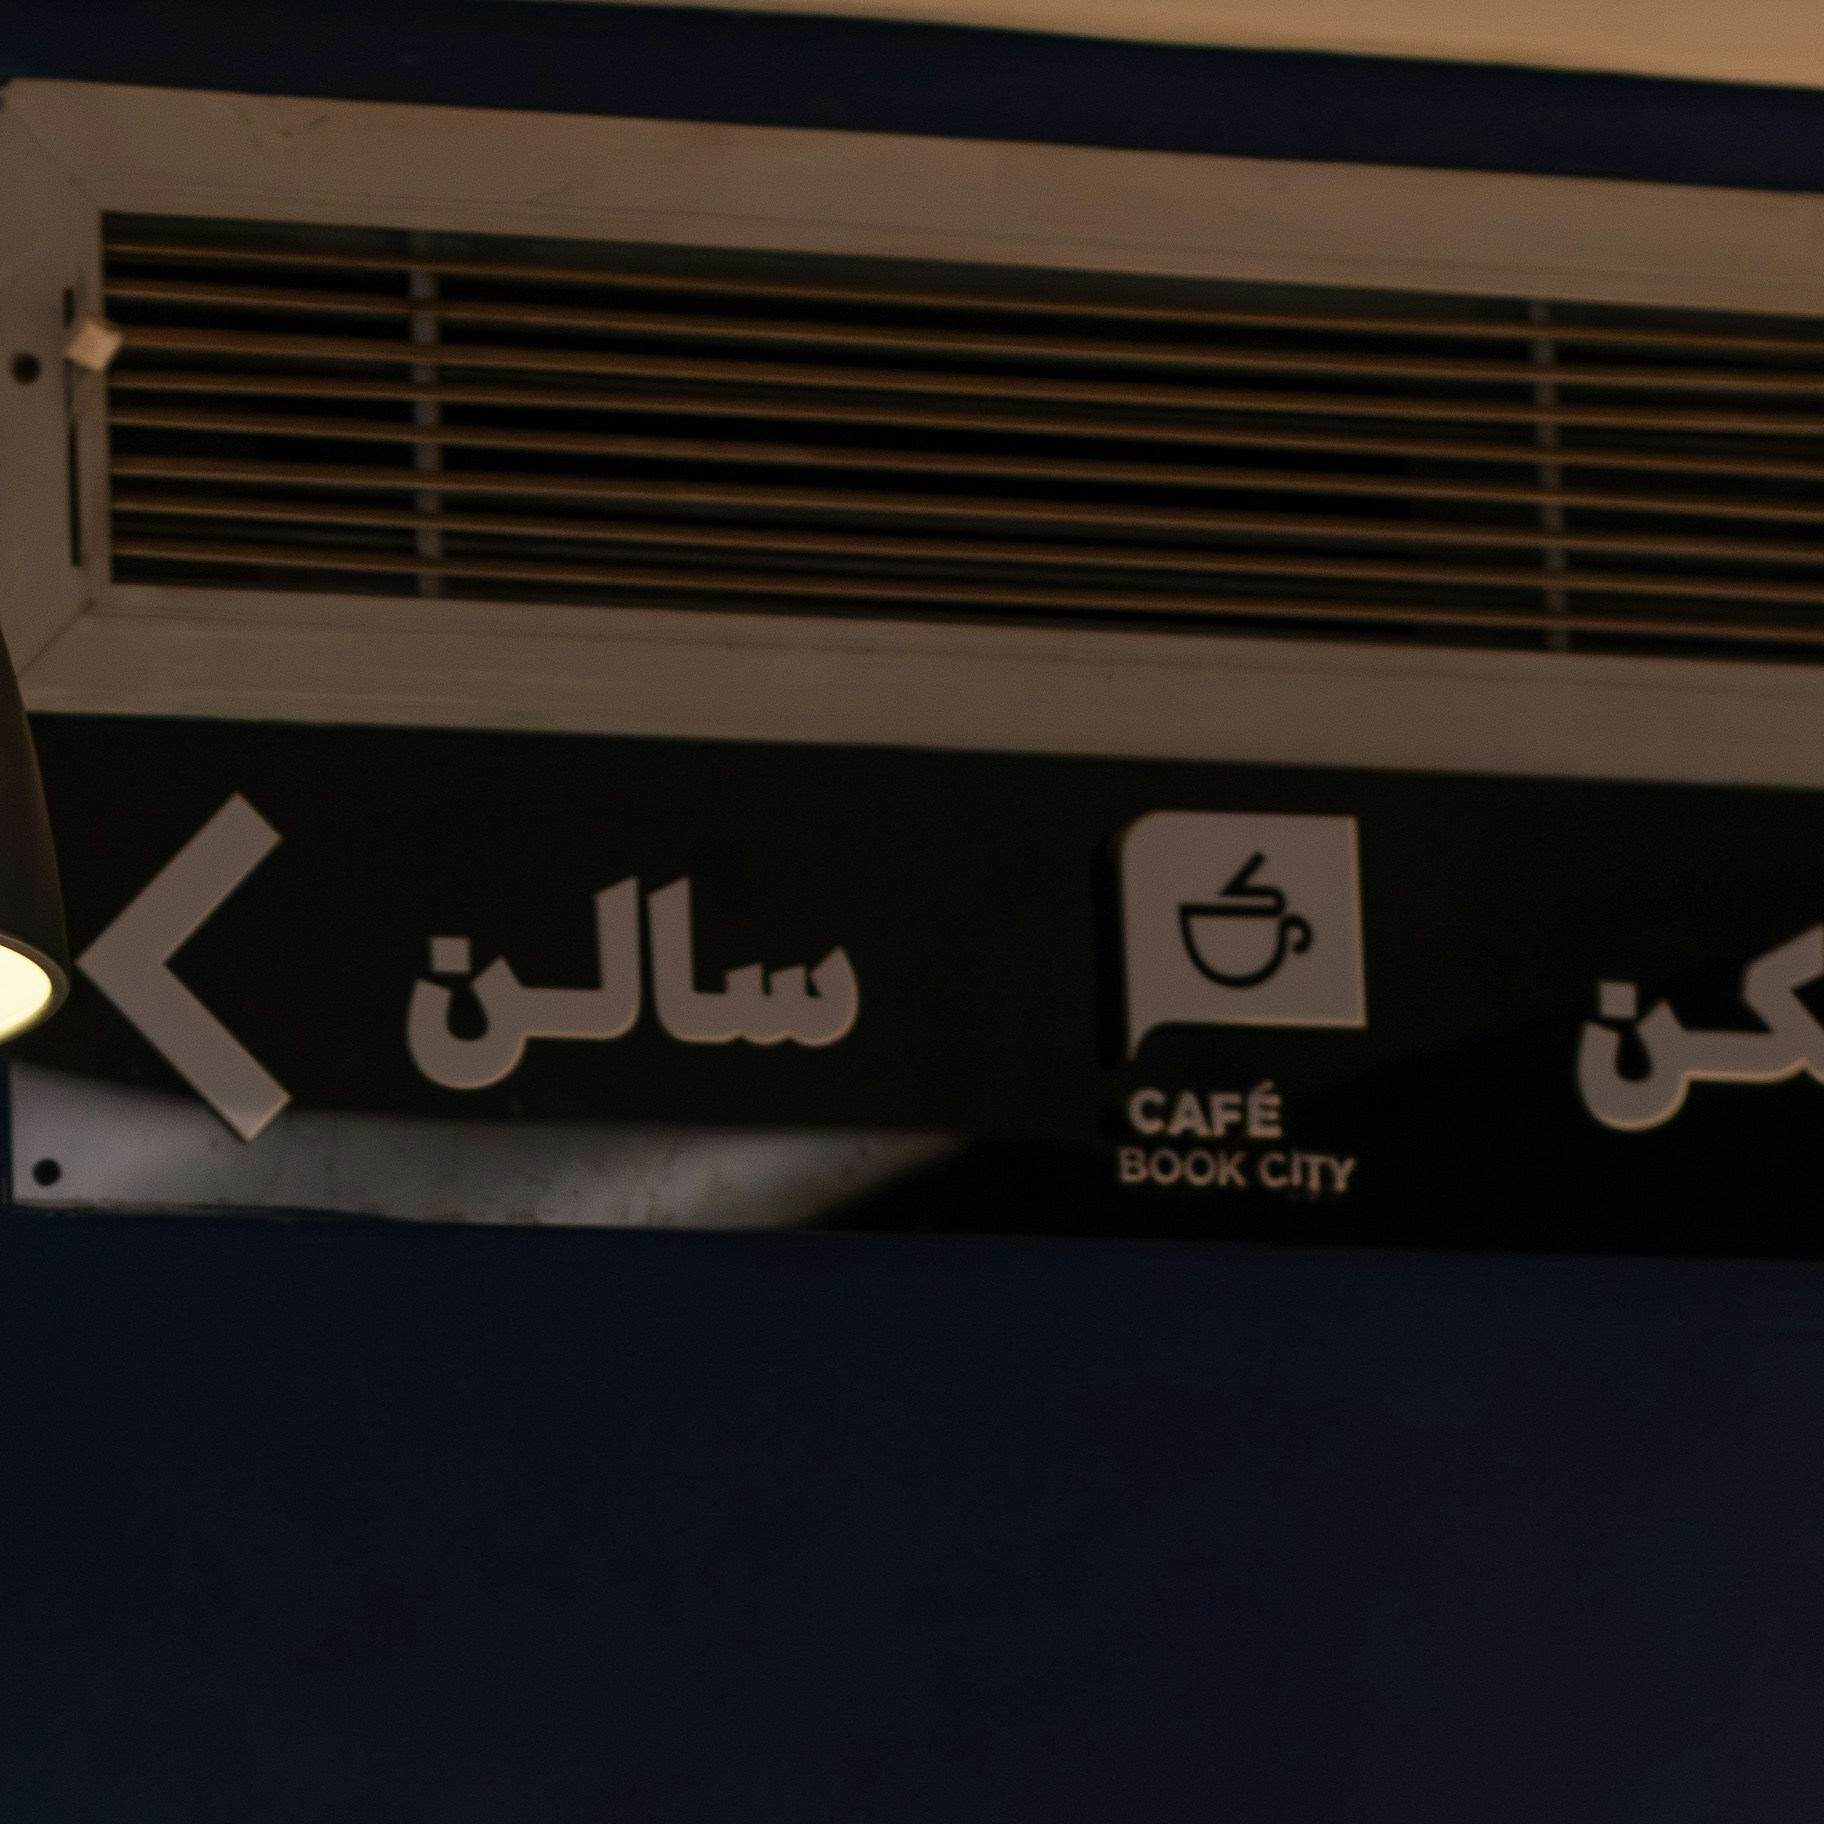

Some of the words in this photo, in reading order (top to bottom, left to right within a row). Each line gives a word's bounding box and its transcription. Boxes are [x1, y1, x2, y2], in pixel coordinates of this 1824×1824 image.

[406, 874, 860, 1091] سالن
[1126, 1078, 1283, 1138] CAFÉ
[1117, 1146, 1249, 1189] BOOK
[1256, 1150, 1357, 1195] CITY
